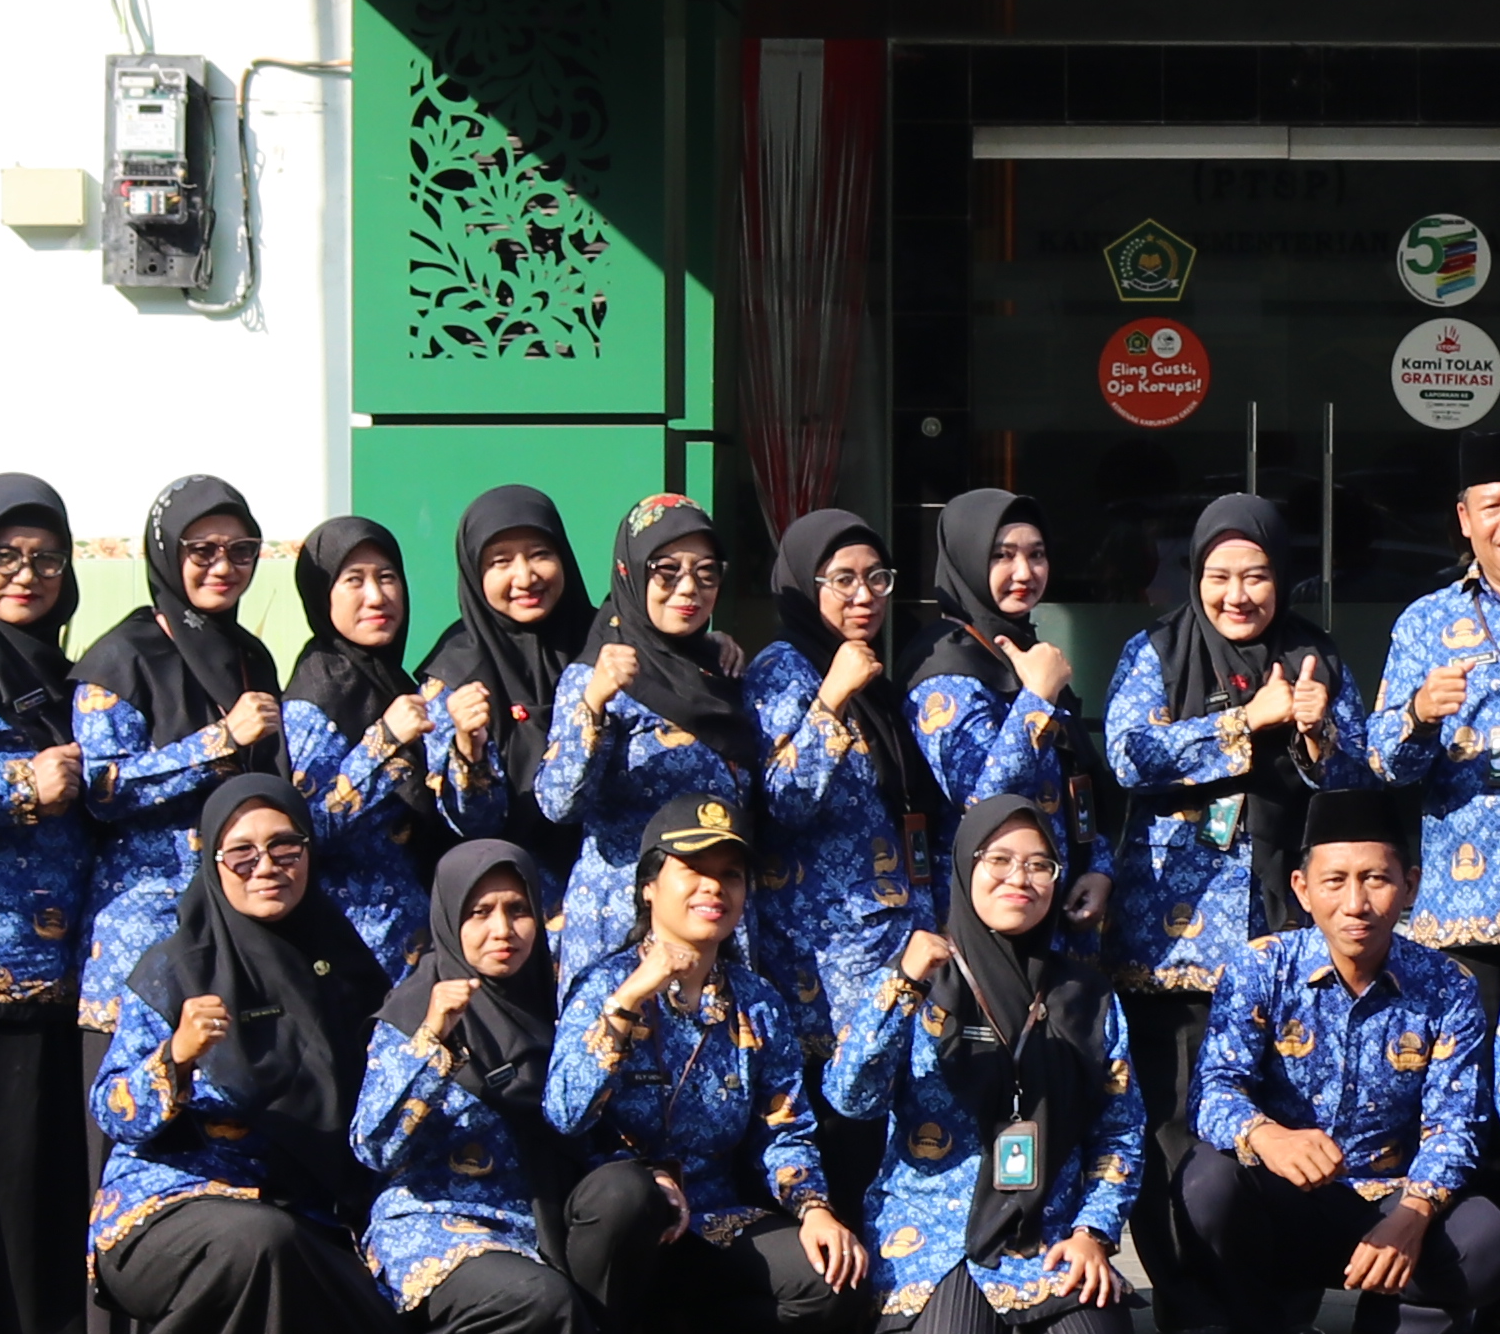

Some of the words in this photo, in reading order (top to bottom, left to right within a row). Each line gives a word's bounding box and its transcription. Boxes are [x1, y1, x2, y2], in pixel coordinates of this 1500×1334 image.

[1111, 362, 1147, 380] Eling
[1151, 361, 1197, 376] Gusti,
[1401, 357, 1442, 370] Kami
[1445, 358, 1494, 372] TOLAK
[1106, 380, 1135, 397] Ojo
[1138, 378, 1202, 397] Korupsi!
[1401, 372, 1494, 386] GRATIFIKASI
